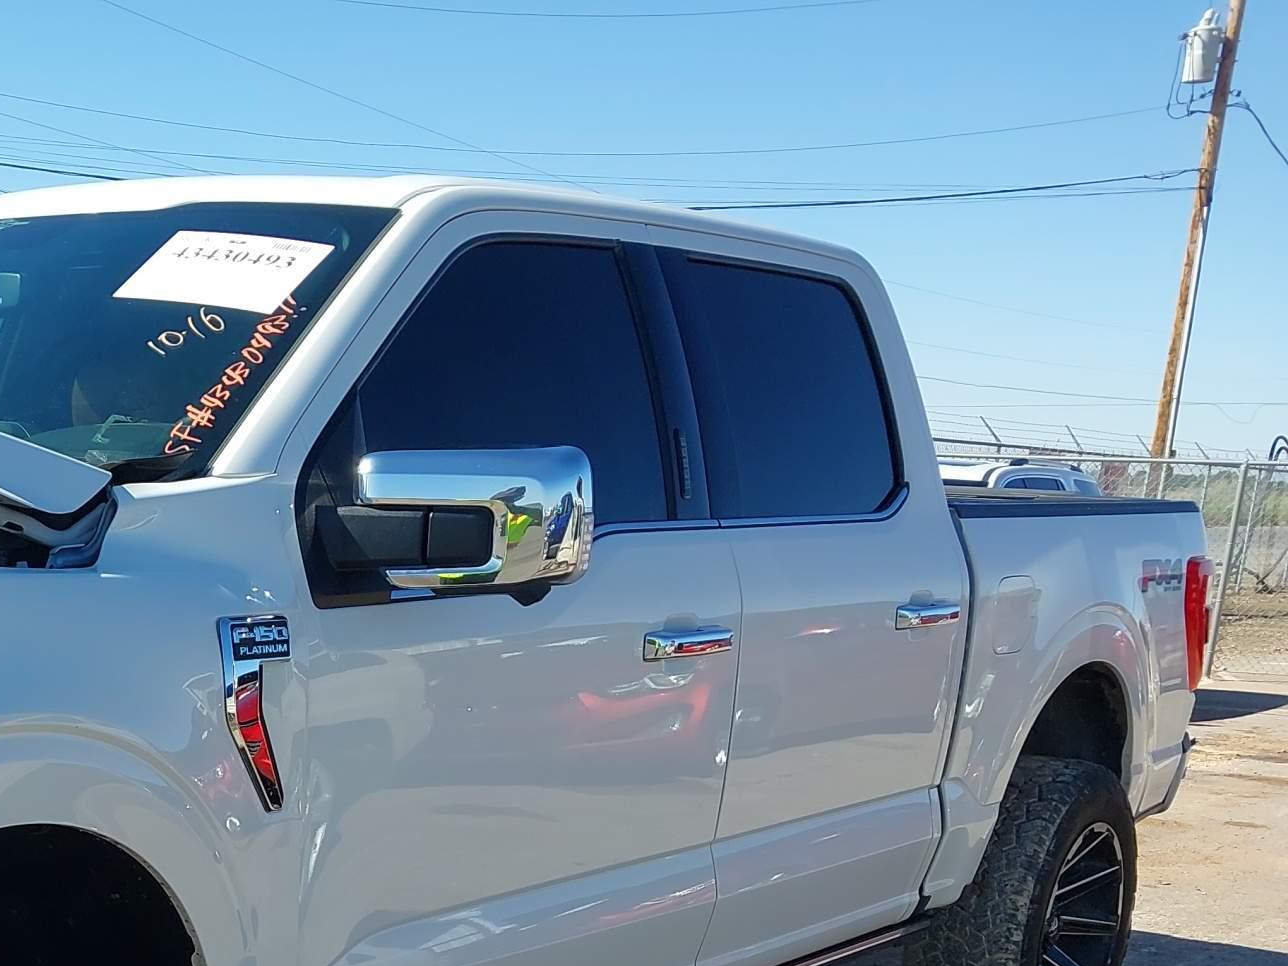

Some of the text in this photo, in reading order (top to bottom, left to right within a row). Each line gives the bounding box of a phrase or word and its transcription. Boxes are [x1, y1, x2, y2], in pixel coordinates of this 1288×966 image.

[172, 246, 297, 269] 43430493
[232, 625, 289, 644] F-150
[239, 643, 288, 656] PLATINUM
